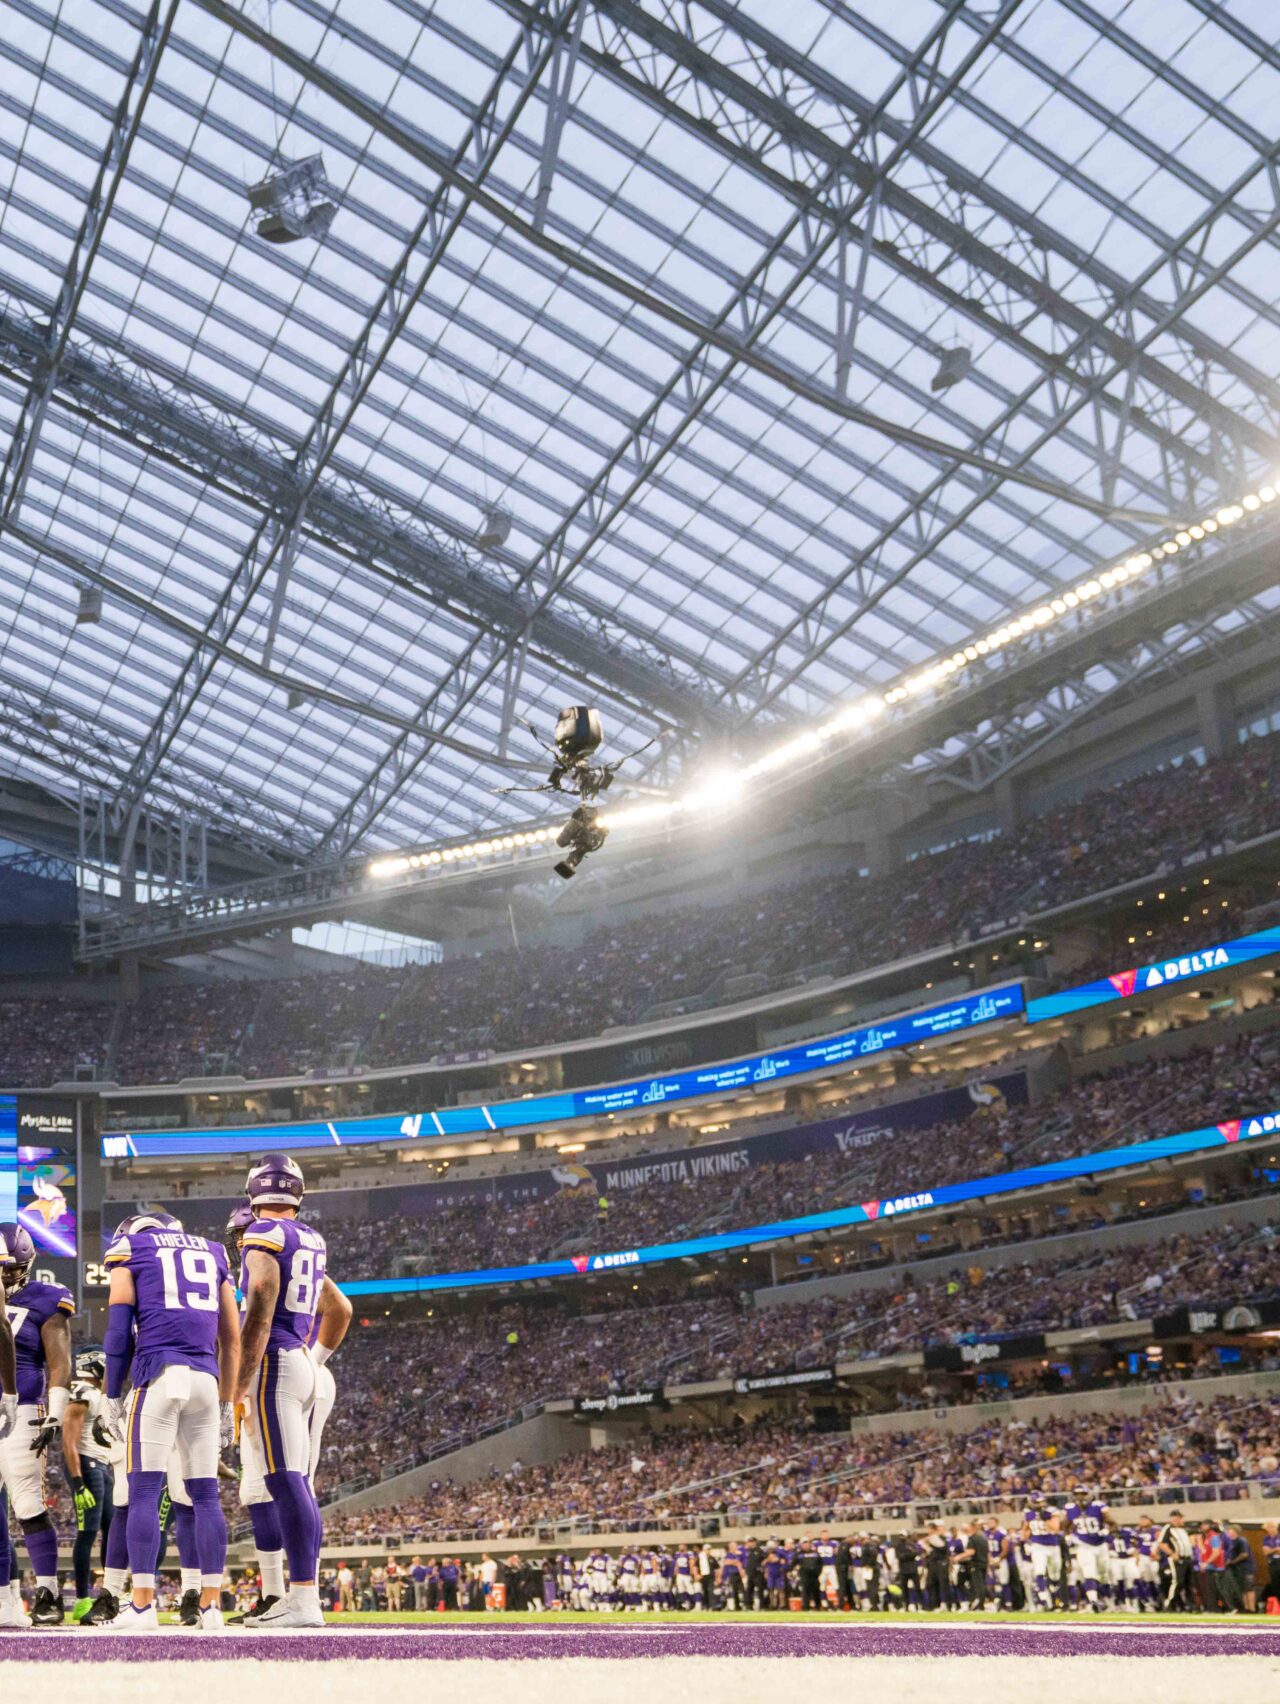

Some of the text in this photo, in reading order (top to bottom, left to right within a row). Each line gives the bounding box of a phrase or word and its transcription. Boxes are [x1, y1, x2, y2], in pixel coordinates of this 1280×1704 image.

[1163, 947, 1230, 981] DELTA
[691, 1150, 750, 1178] VIKINGS
[485, 1192, 504, 1202] OF
[513, 1188, 539, 1198] THE
[894, 1192, 934, 1211] DELTA
[150, 1233, 209, 1251] THIELEN
[604, 1251, 640, 1267] DELTA
[86, 1264, 111, 1285] 25
[156, 1247, 219, 1312] 19
